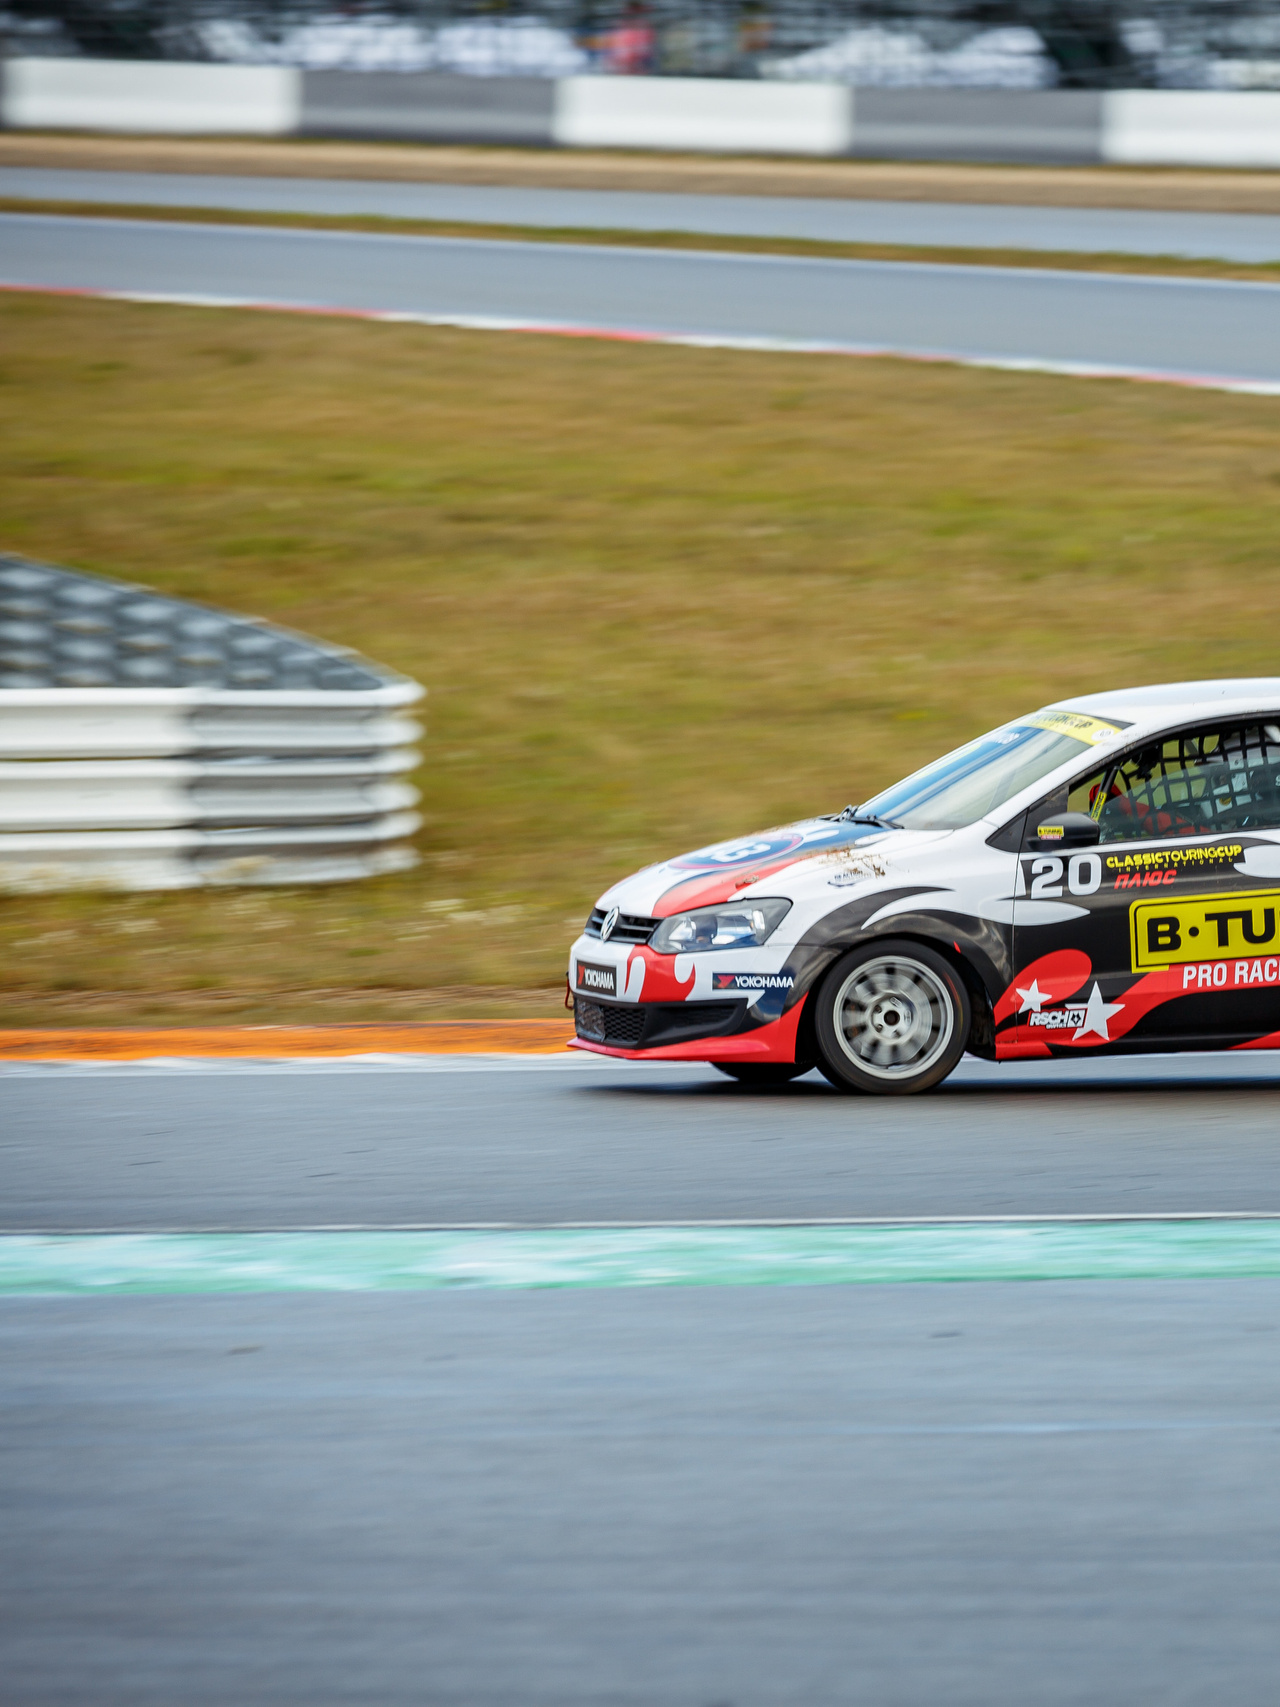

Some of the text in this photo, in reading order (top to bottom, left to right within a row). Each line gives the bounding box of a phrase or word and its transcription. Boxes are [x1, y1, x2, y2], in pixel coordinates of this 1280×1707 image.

[1106, 844, 1242, 868] CLASSICTOURINGCUP
[1031, 853, 1102, 900] 20
[584, 968, 615, 990] YOKOHAMA
[734, 975, 795, 989] YOKOHAMA
[1182, 962, 1227, 989] PRO
